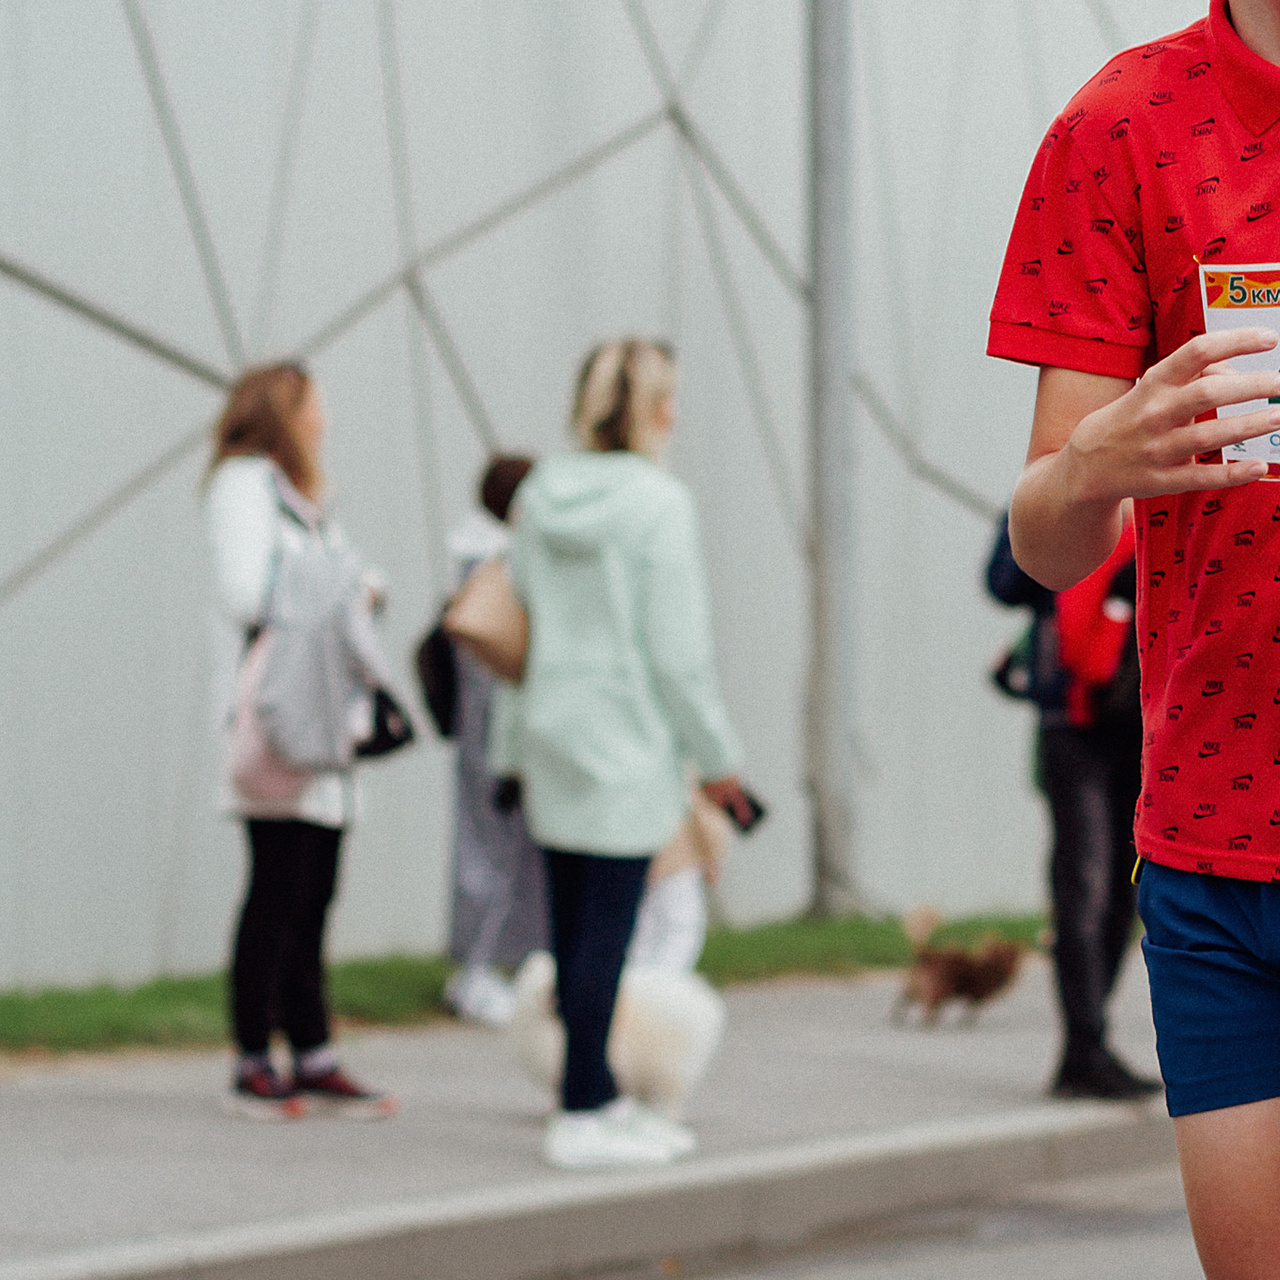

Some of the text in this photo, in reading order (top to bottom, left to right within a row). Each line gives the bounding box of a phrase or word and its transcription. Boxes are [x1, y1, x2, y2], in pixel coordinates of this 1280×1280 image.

[1152, 92, 1174, 100] NIKE
[1244, 142, 1264, 152] NIKE
[1250, 202, 1272, 212] NIKE
[1229, 276, 1247, 303] 5
[1205, 680, 1224, 689] NIKE
